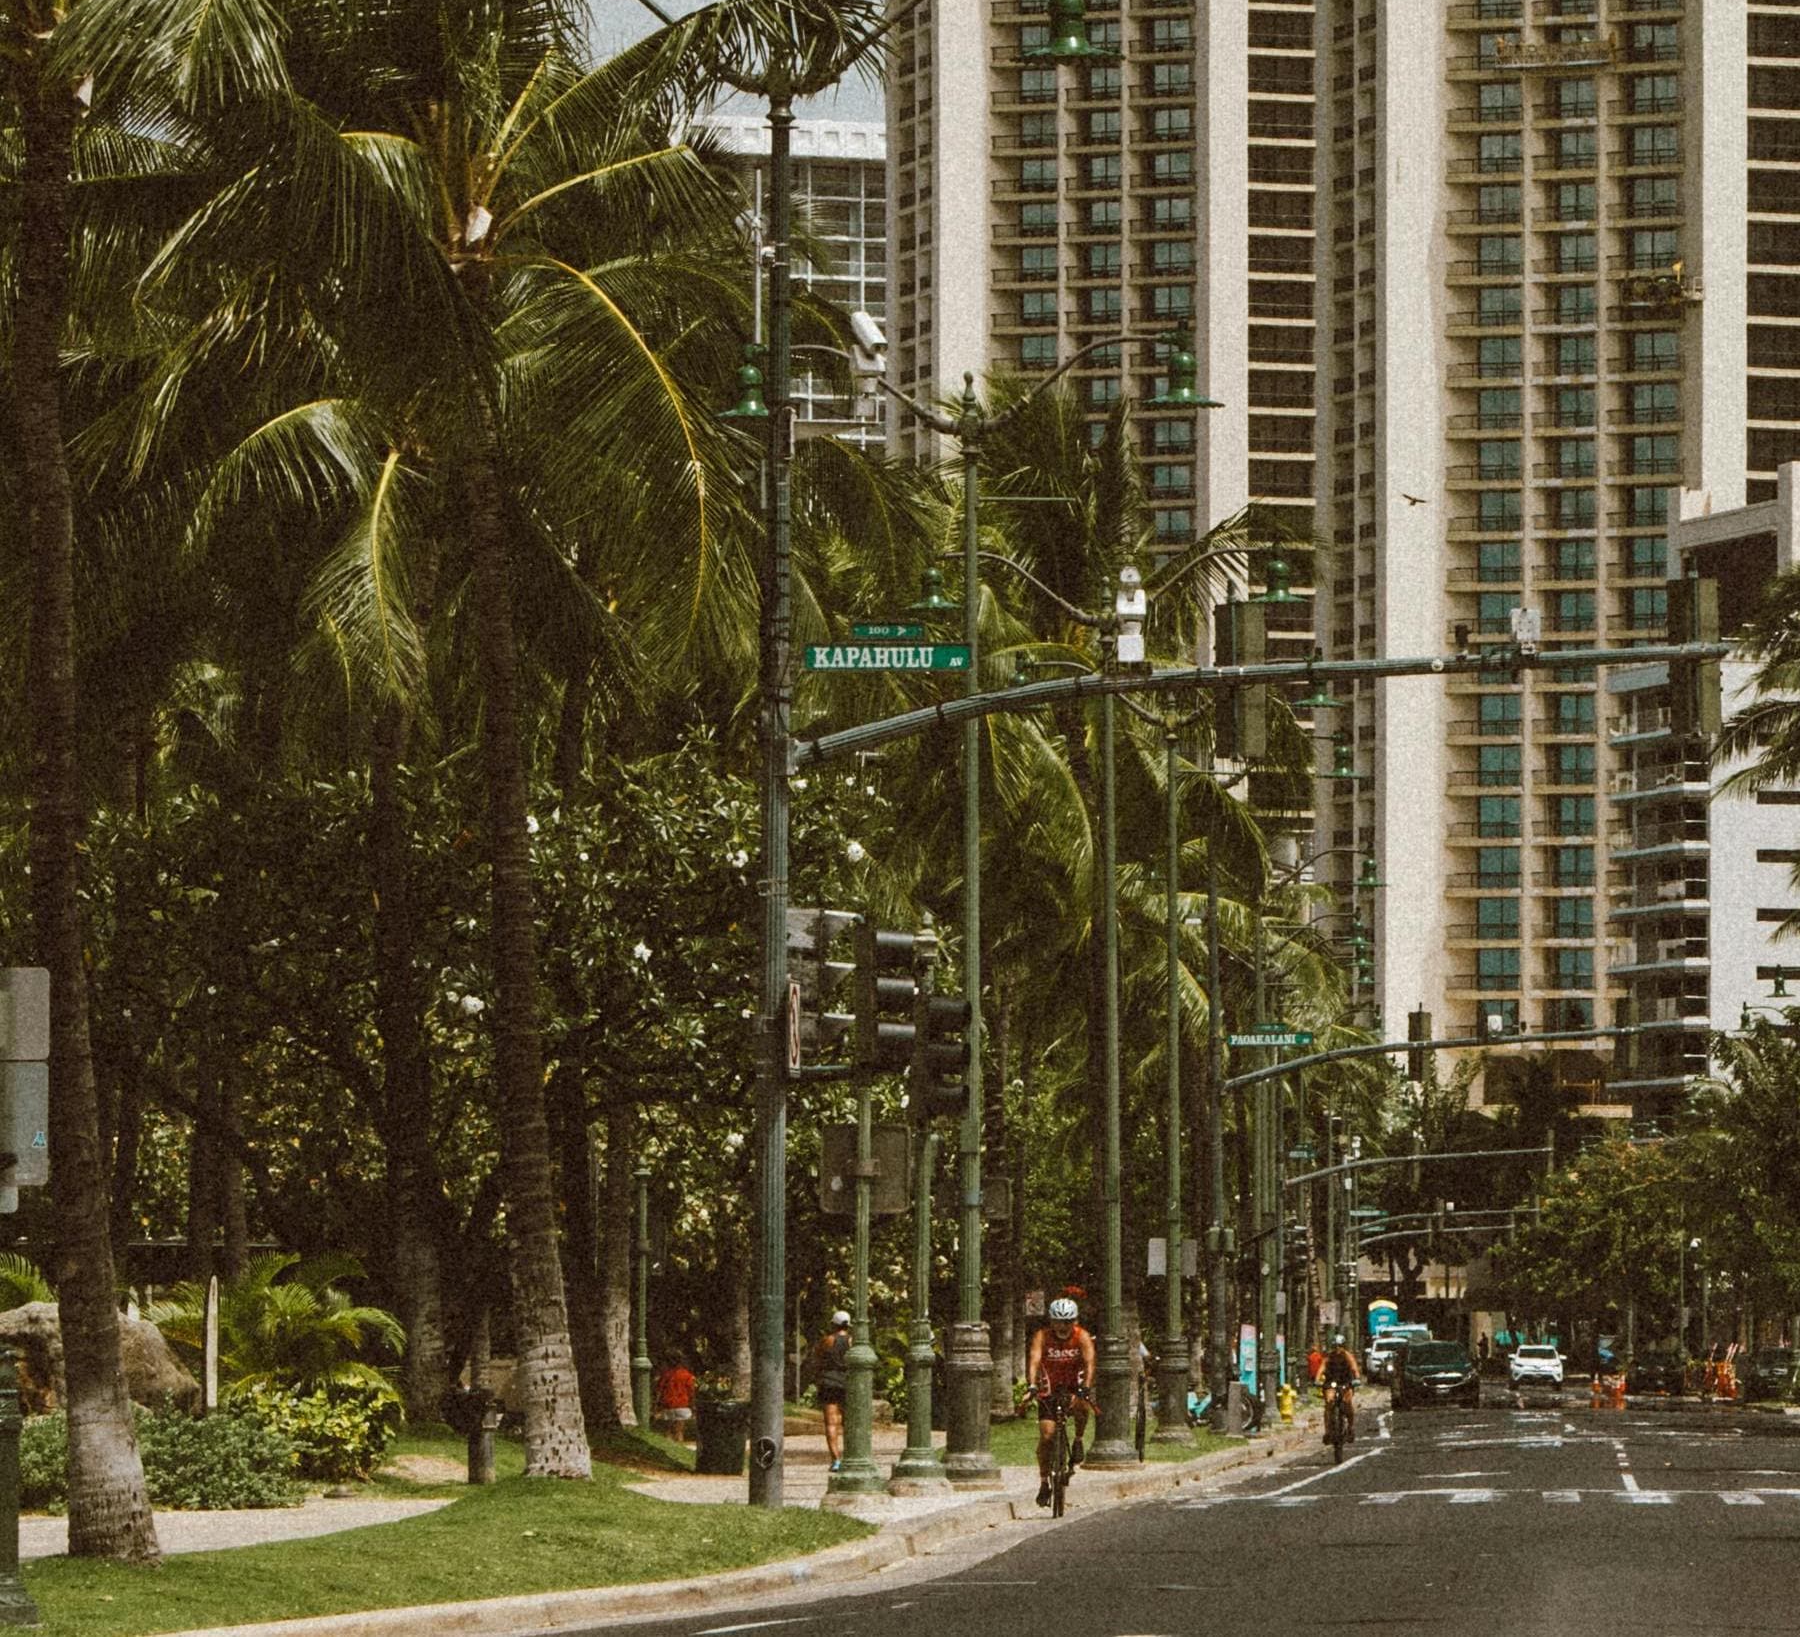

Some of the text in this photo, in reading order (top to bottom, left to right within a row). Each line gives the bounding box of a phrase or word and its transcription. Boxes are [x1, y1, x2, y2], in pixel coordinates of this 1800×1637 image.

[868, 627, 889, 635] 100
[813, 646, 964, 668] KAPAHULU AV
[1230, 1034, 1297, 1045] PAOAKALANI
